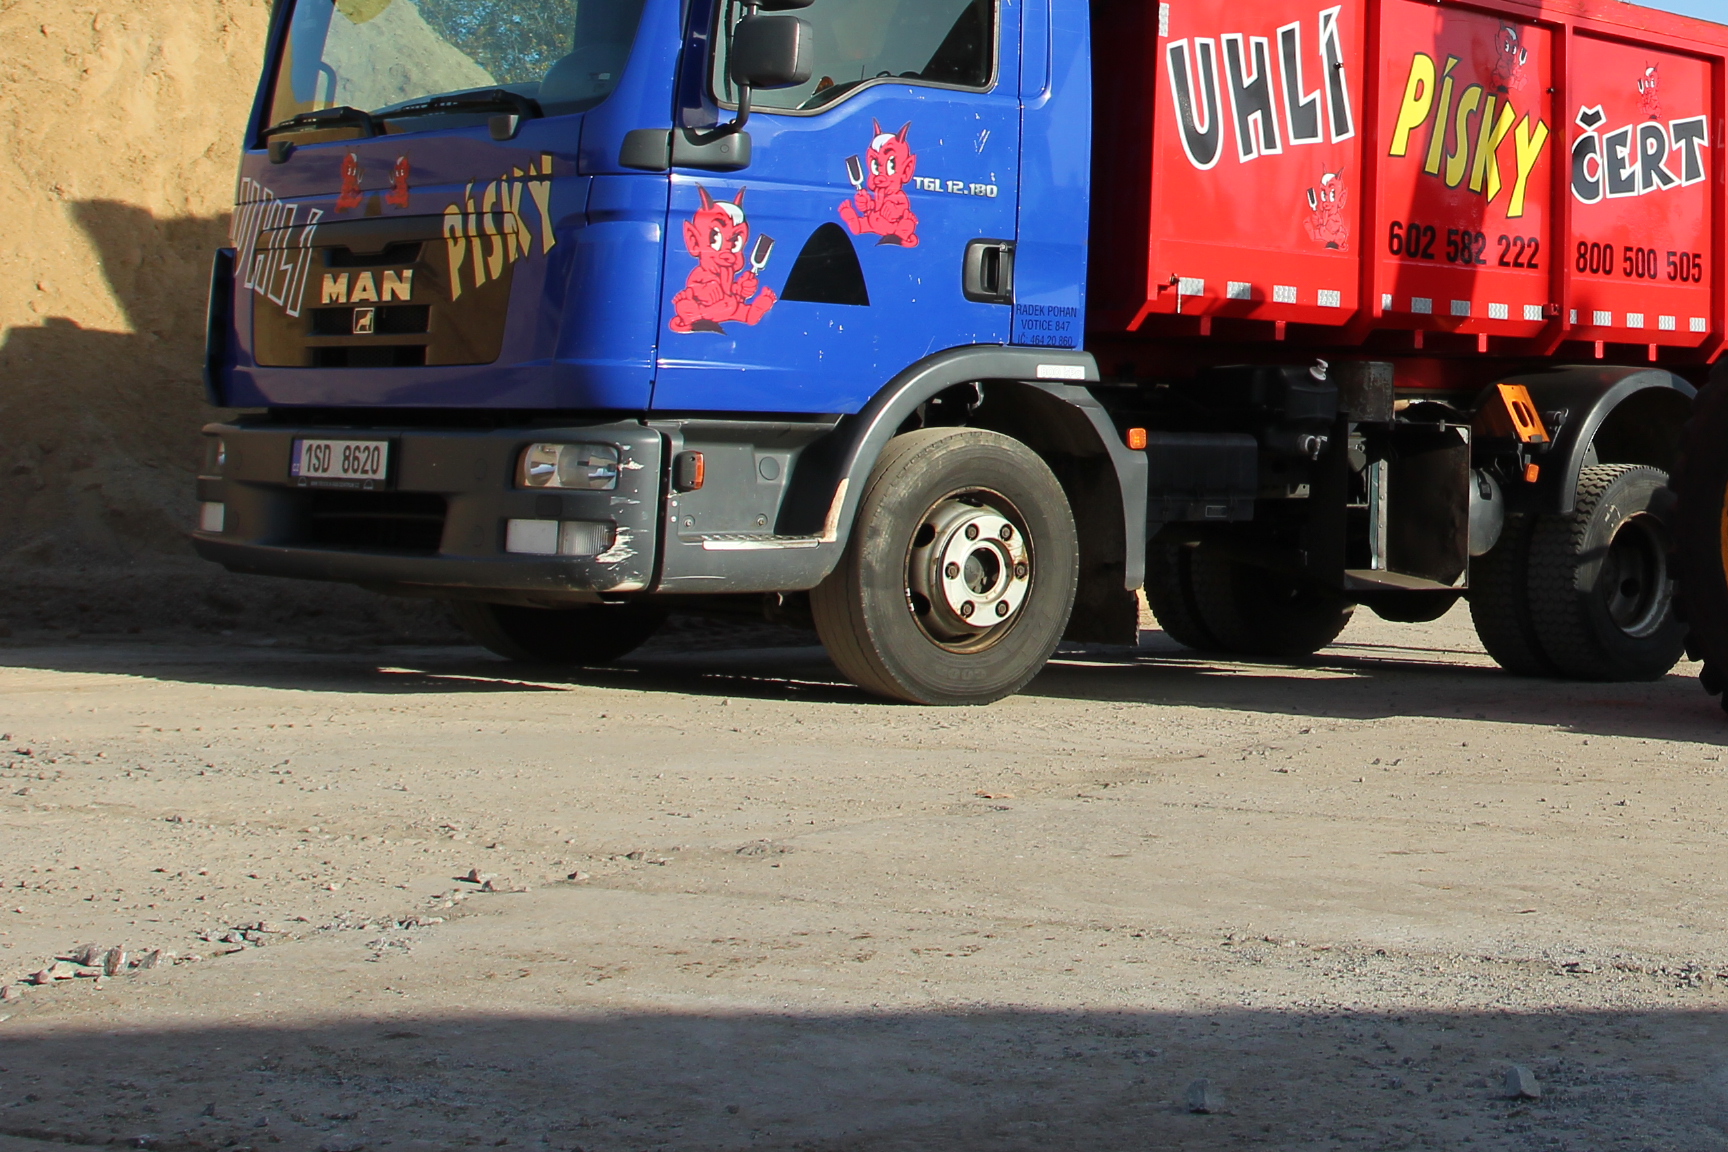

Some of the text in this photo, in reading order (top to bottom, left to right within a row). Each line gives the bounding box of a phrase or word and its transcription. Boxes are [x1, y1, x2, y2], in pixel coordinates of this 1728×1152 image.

[1166, 5, 1355, 171] UHLÍ
[1388, 51, 1550, 219] PÍSKY
[1571, 104, 1709, 204] ČERT
[913, 176, 998, 198] TGL 12.180
[443, 151, 556, 302] PÍSKY
[1389, 220, 1540, 269] 602 582 222
[1576, 240, 1703, 284] 800 500 505
[321, 269, 413, 304] MAN
[1016, 304, 1077, 317] RADEK POHAN
[1021, 319, 1070, 331] VOTICE 847
[1030, 335, 1044, 345] 464
[1046, 336, 1056, 345] 20
[306, 444, 380, 475] 1SD 8620
